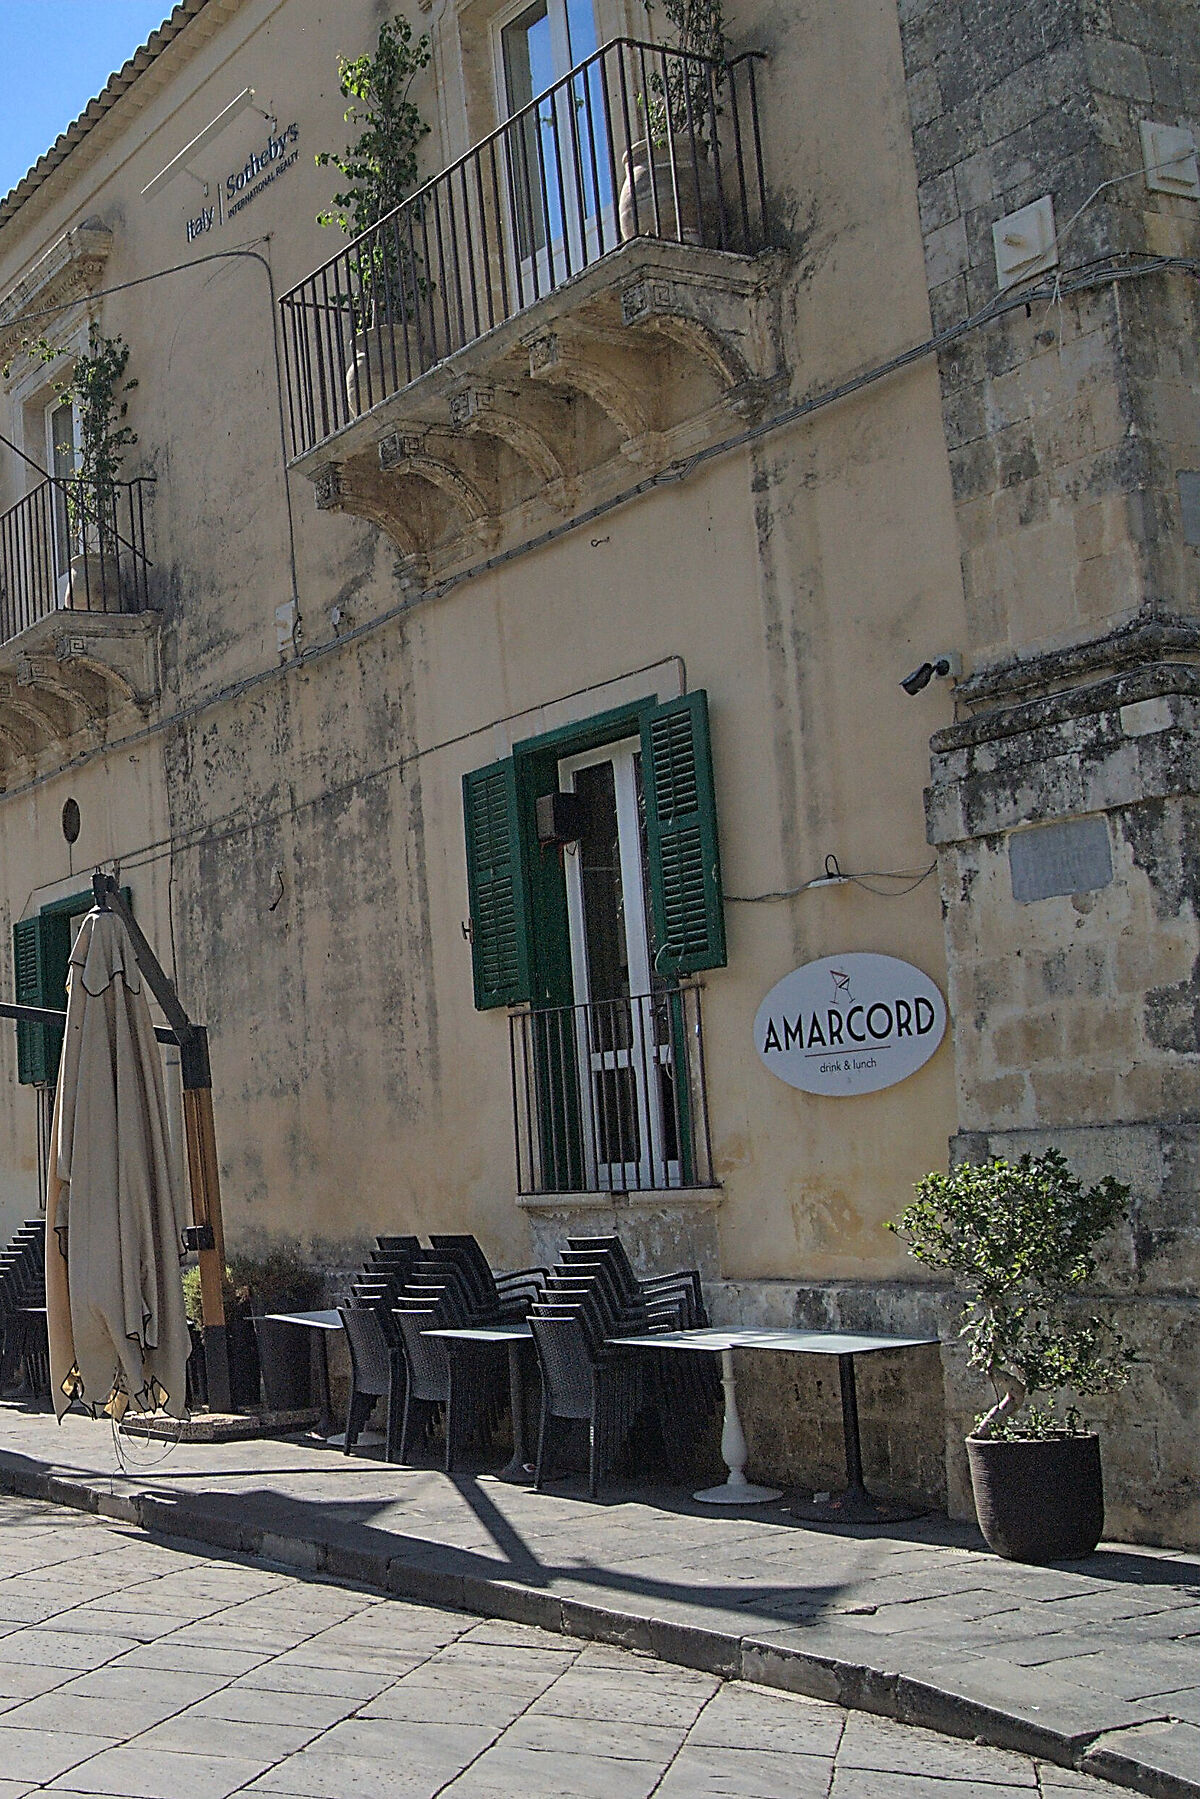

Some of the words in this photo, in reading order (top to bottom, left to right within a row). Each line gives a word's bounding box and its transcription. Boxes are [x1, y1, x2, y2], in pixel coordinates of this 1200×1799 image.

[186, 206, 215, 243] Italy
[226, 122, 299, 200] Sotheby's
[227, 171, 275, 219] INTERNATIONAL
[275, 149, 299, 177] REALTY
[763, 997, 935, 1053] AMARCORD
[820, 1061, 841, 1073] drink
[843, 1059, 851, 1071] &
[852, 1057, 877, 1070] lunch
